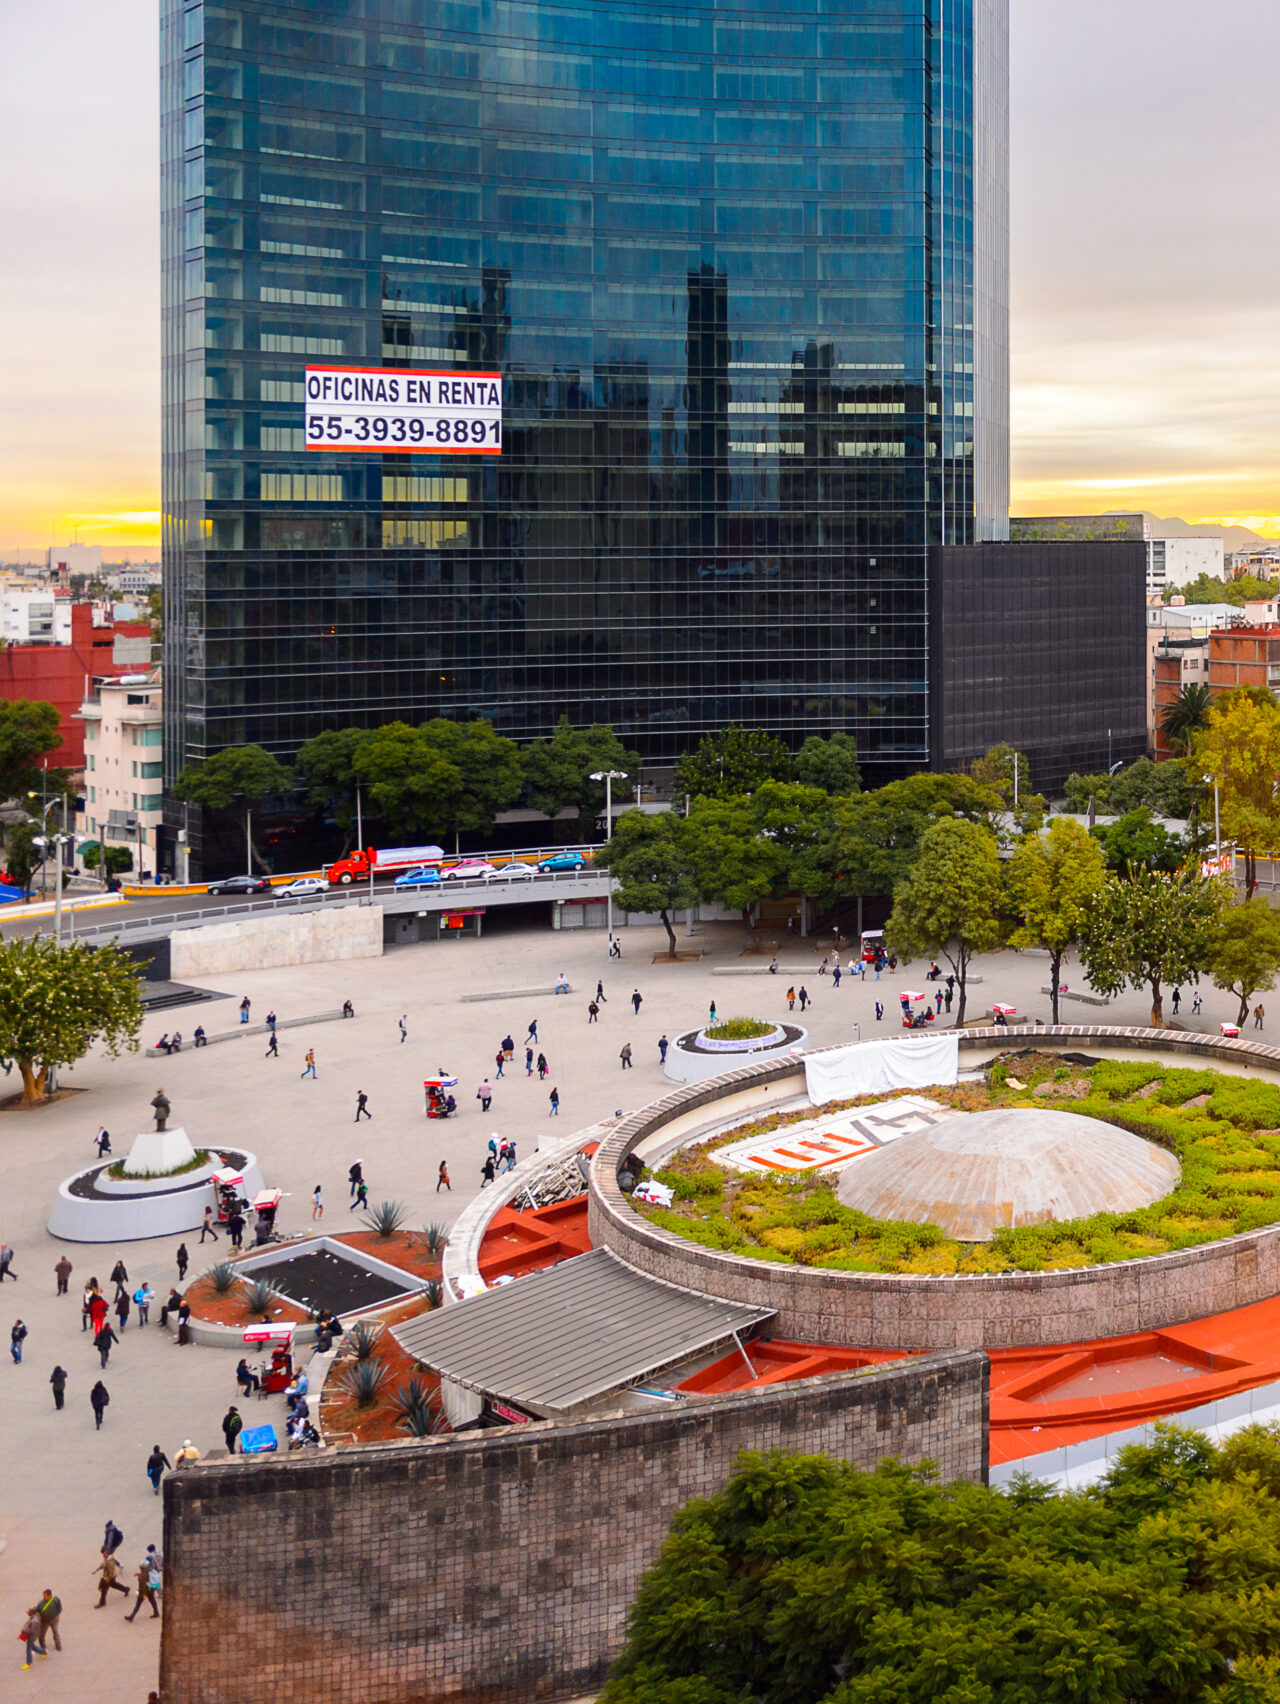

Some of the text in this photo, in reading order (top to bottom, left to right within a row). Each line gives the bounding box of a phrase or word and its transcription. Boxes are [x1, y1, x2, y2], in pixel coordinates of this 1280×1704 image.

[308, 375, 500, 406] OFICINAS EN RENTA
[308, 415, 500, 444] 55-3939-8891
